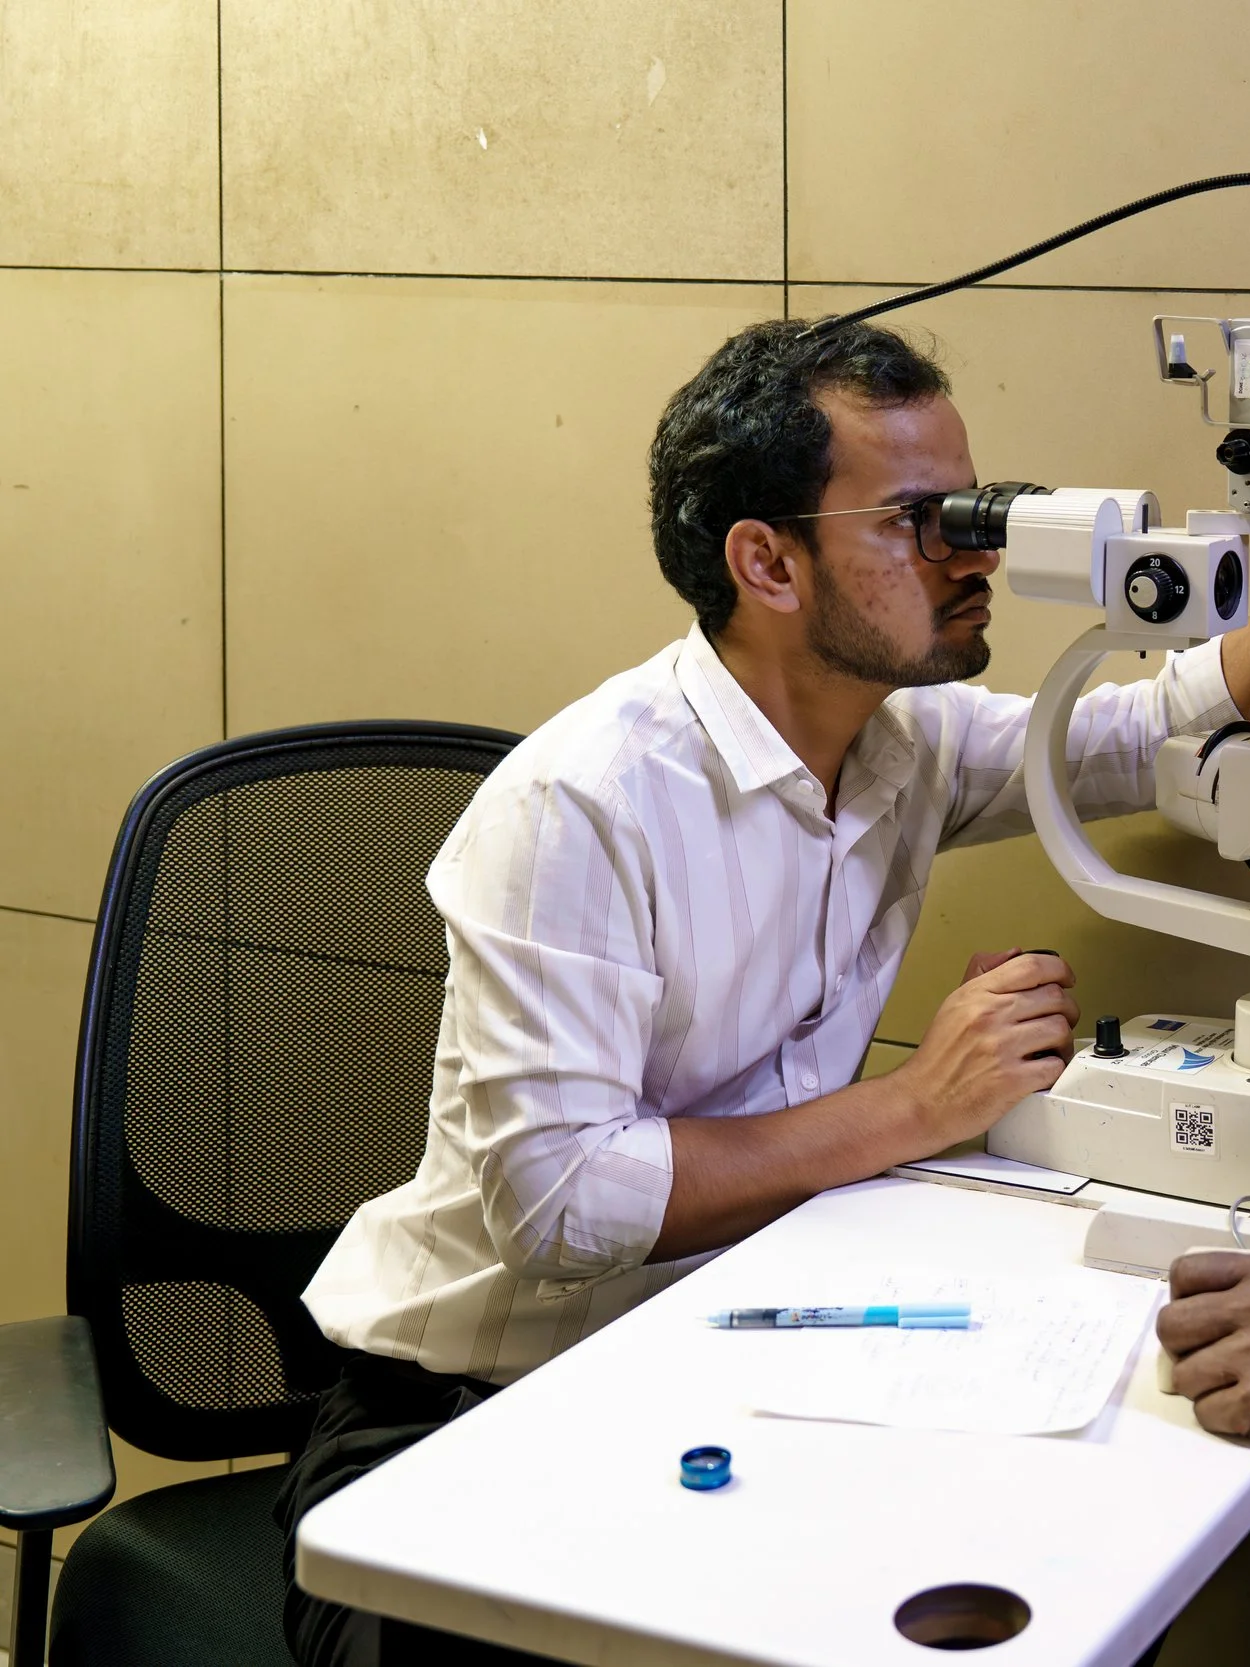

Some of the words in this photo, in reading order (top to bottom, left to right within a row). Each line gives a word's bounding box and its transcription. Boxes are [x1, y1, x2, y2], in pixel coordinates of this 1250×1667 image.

[1149, 558, 1160, 567] 20
[1175, 585, 1184, 594] 12
[1152, 611, 1158, 620] 8
